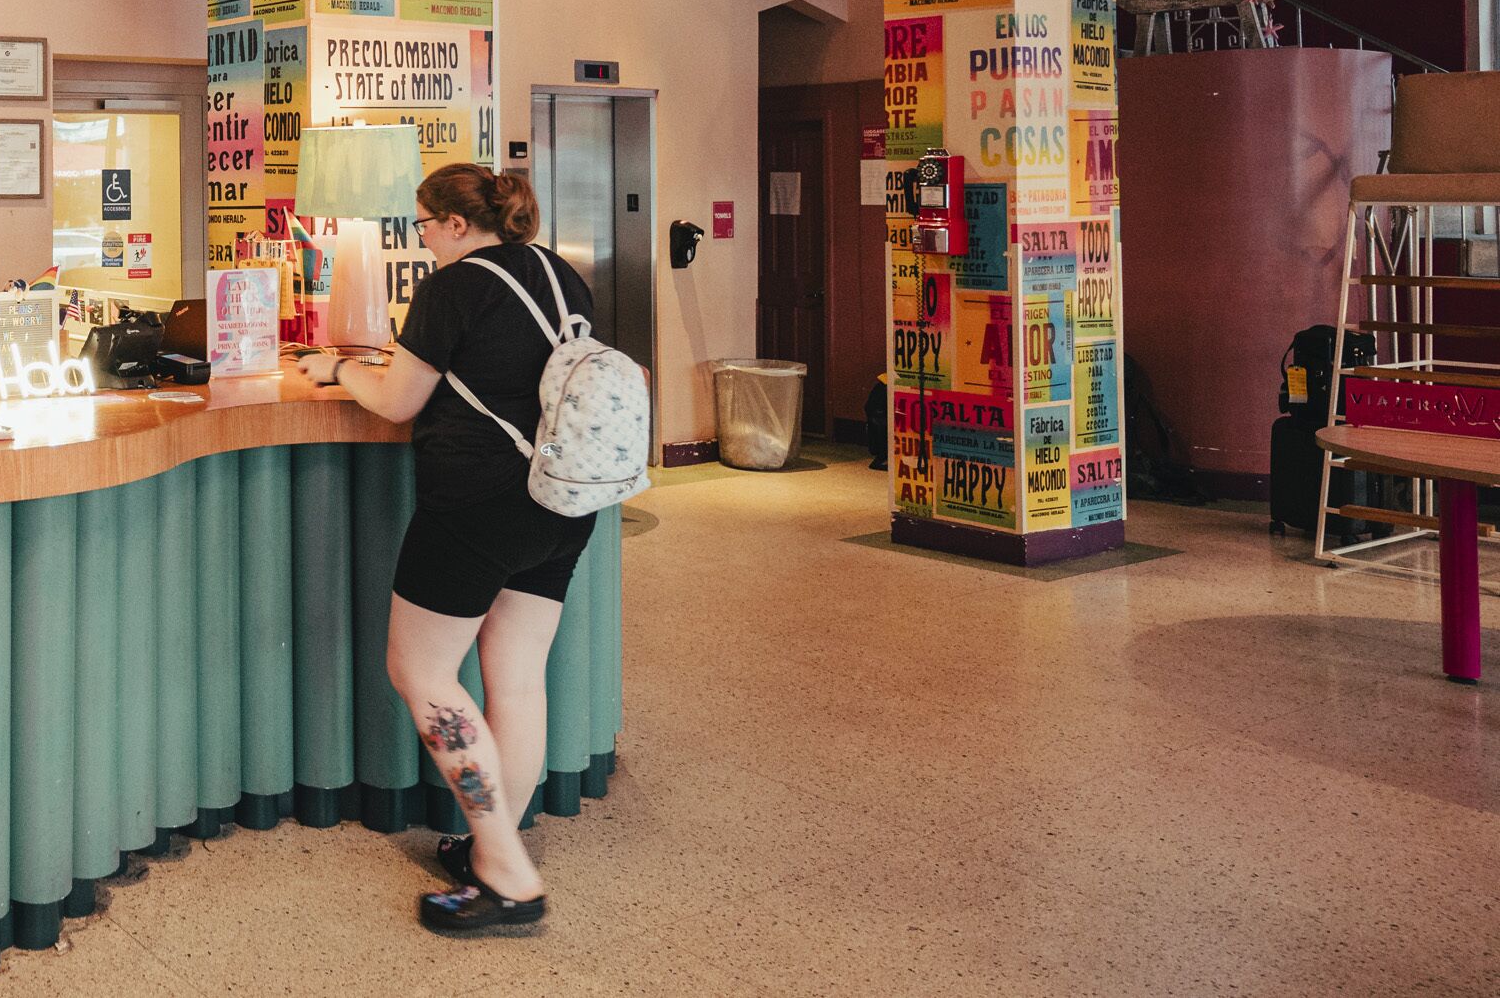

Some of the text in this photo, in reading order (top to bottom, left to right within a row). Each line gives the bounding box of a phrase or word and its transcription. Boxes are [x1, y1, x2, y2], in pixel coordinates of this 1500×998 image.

[995, 13, 1048, 39] EN LOS
[1089, 12, 1097, 22] DE
[1081, 22, 1105, 41] HIELO
[327, 38, 459, 70] PRECOLOMBINO
[969, 46, 1063, 82] PUEBLOS
[1073, 43, 1110, 68] MACONDO
[271, 66, 281, 79] DE
[335, 72, 452, 102] STATE of MIND
[1089, 126, 1099, 136] EL
[980, 125, 1065, 168] COSAS
[1089, 185, 1099, 196] EL
[382, 217, 407, 250] EN
[1022, 230, 1068, 252] SALTA
[1081, 221, 1110, 264] TODO
[1078, 277, 1113, 319] HAPPY
[3, 331, 14, 341] WE
[1078, 347, 1114, 364] LIBERTAD
[1090, 381, 1101, 392] ser
[1030, 417, 1064, 434] Fábrica
[1044, 435, 1053, 445] DE
[1035, 447, 1061, 465] HIELO
[1028, 468, 1067, 494] MACONDO
[1077, 458, 1122, 484] SALTA
[944, 459, 1006, 509] HAPPY
